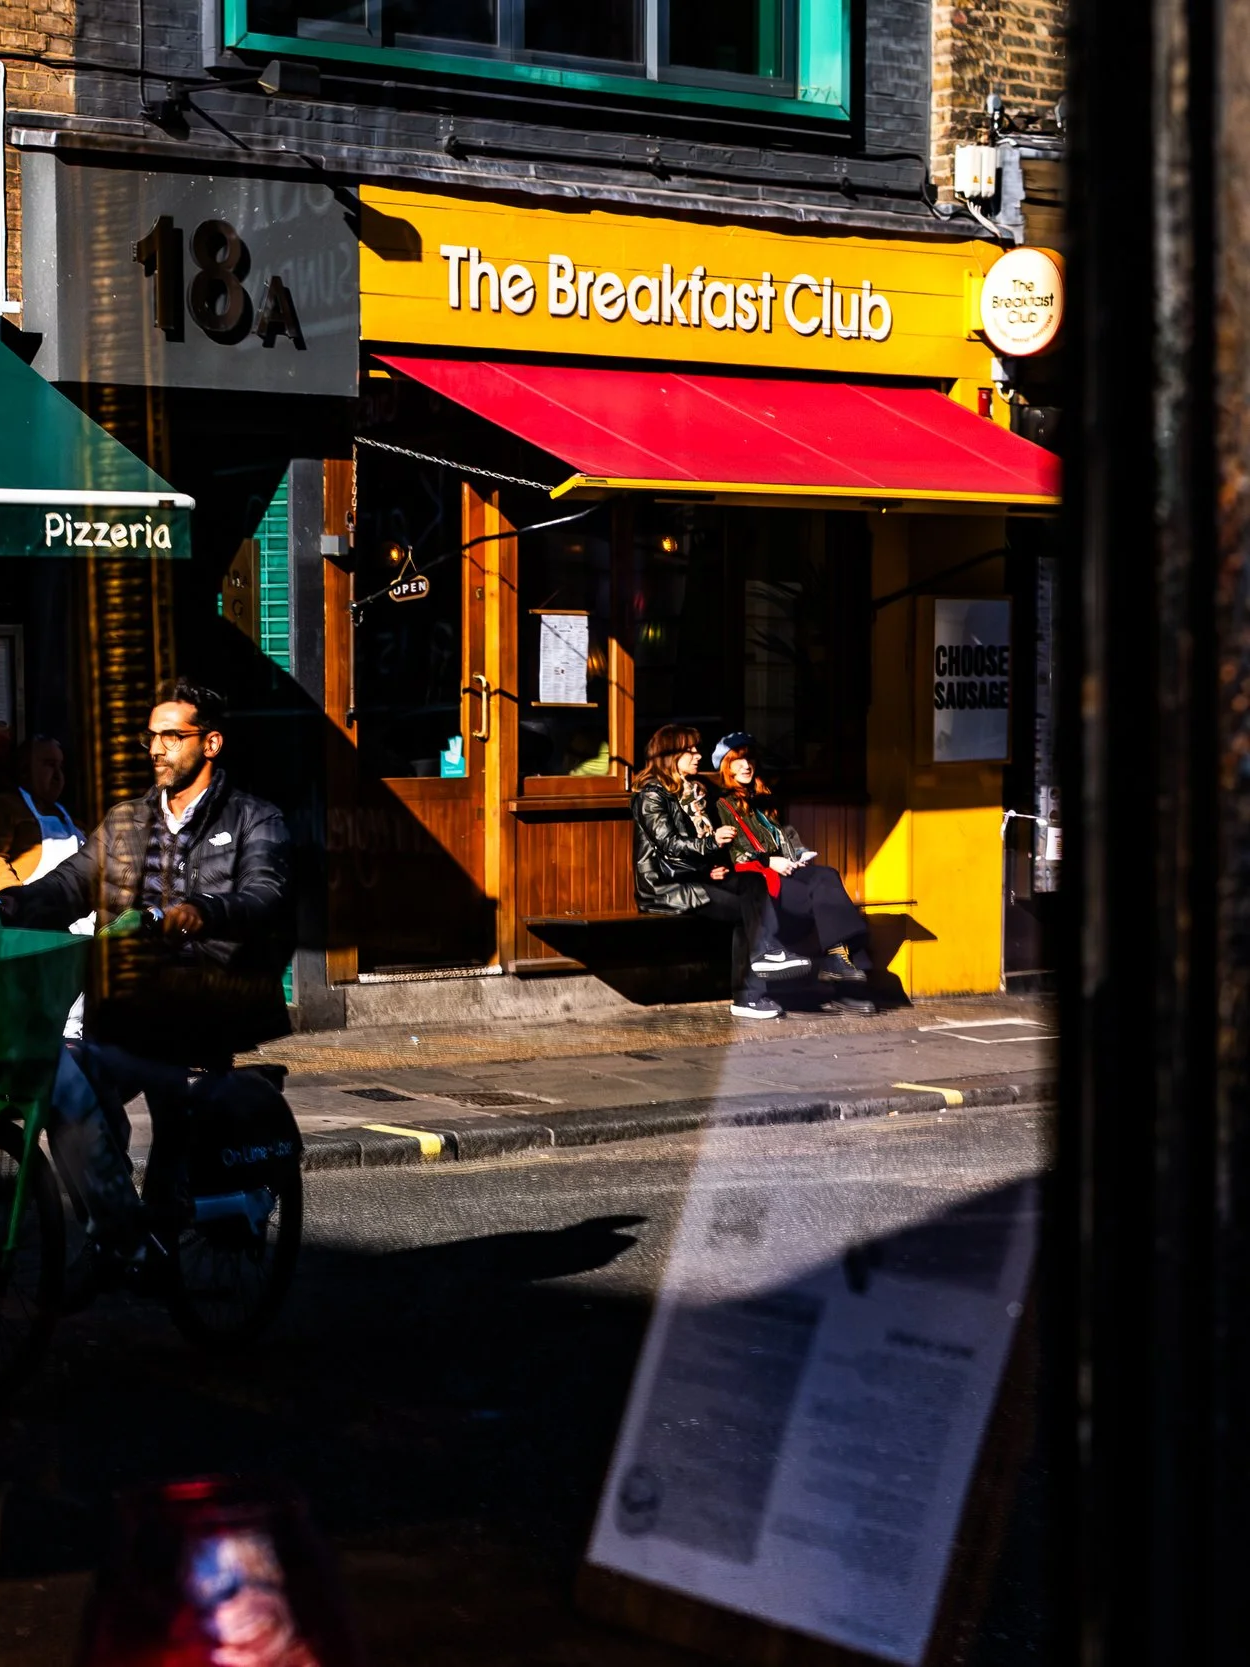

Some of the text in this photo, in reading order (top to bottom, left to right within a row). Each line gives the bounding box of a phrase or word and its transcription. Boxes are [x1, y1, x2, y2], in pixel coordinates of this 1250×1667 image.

[439, 244, 893, 341] The Breakfast Club
[1011, 279, 1035, 293] The
[1007, 310, 1039, 324] Club
[45, 512, 172, 549] Pizzeria
[393, 581, 426, 596] OPEN
[935, 644, 1010, 678] CHOOSE
[933, 681, 1010, 710] SAUSAGE
